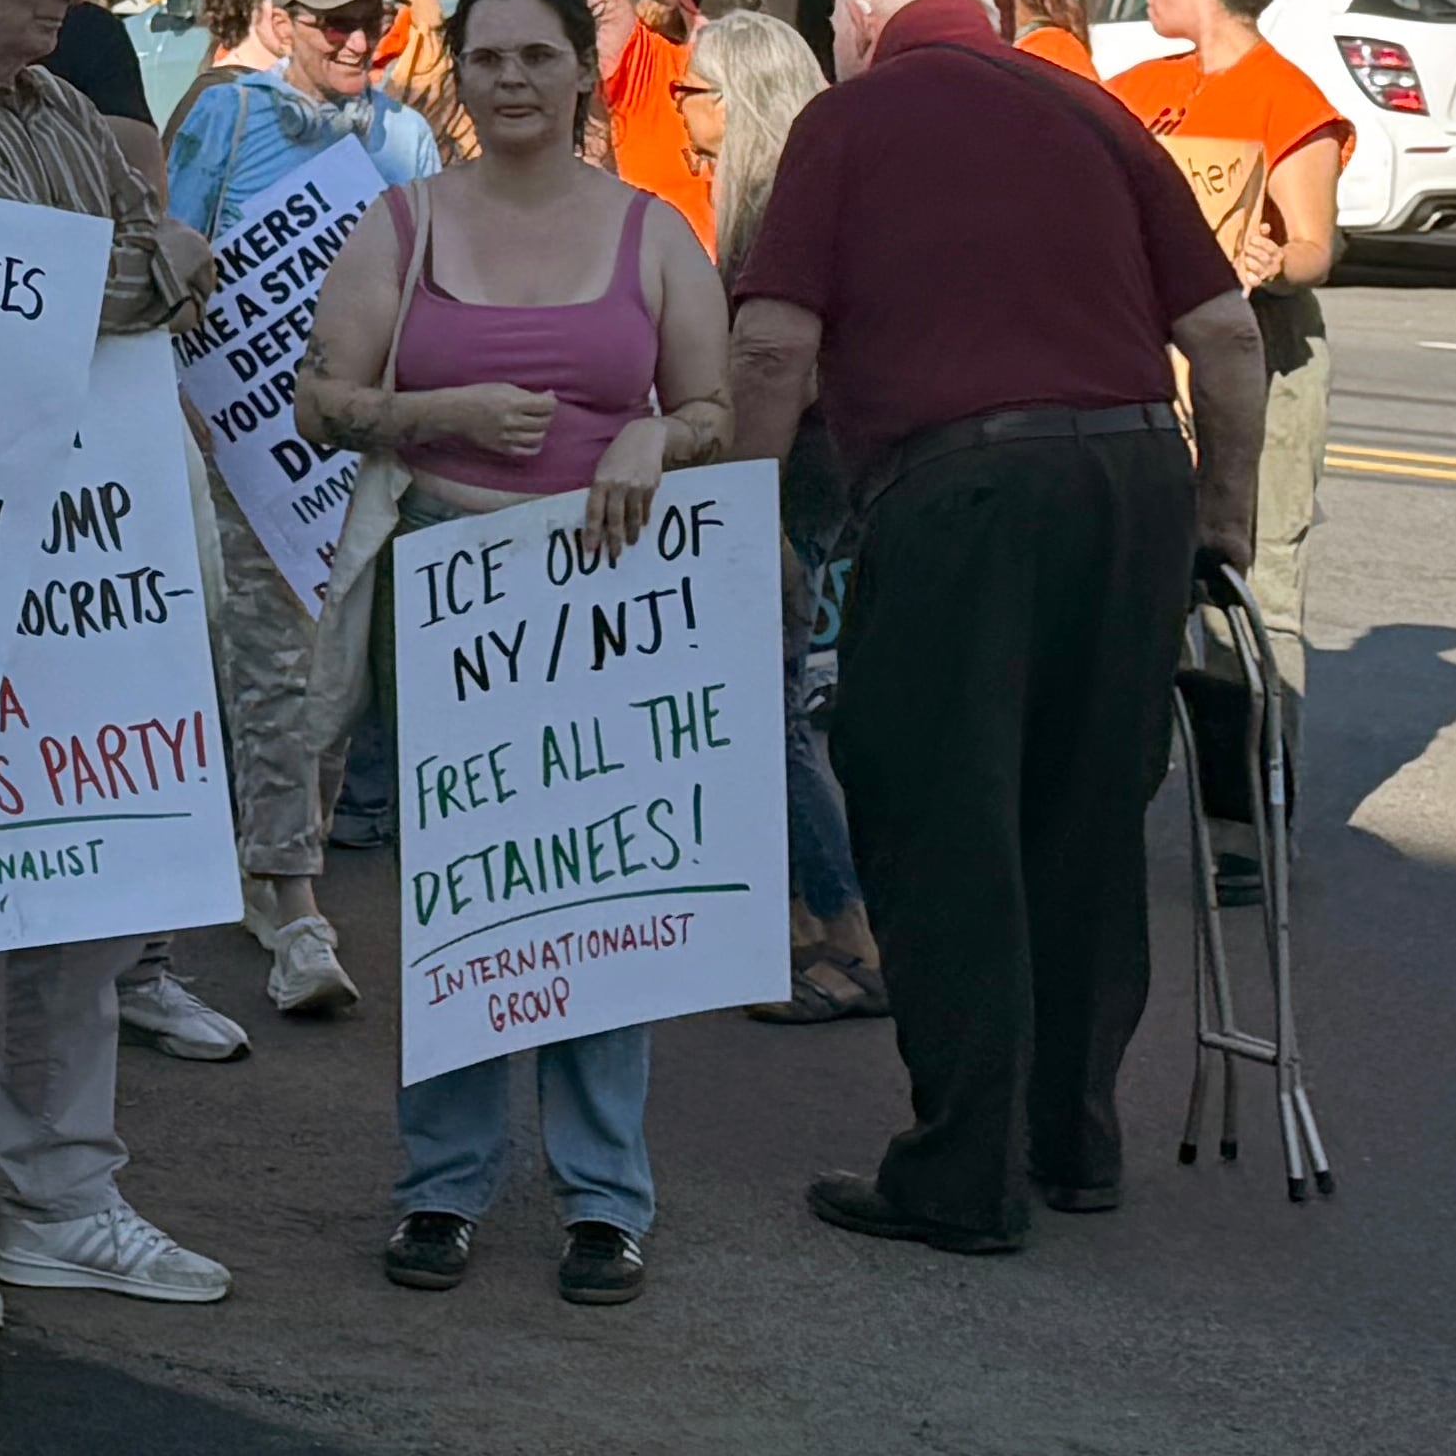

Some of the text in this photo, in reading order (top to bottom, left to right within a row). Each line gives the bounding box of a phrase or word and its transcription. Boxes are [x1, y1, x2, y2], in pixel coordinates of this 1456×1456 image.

[234, 292, 269, 329] A
[17, 565, 194, 639] OCRATS-
[416, 499, 725, 629] ICE OU OF
[452, 575, 700, 701] NY/NJ!
[0, 675, 30, 733] A
[39, 710, 209, 807] PARTY!
[416, 684, 732, 831] FREE ALL THE
[412, 784, 703, 928] DETAINEES!
[425, 911, 695, 1007] INTERNATIONALIST
[486, 976, 570, 1034] GROUP
